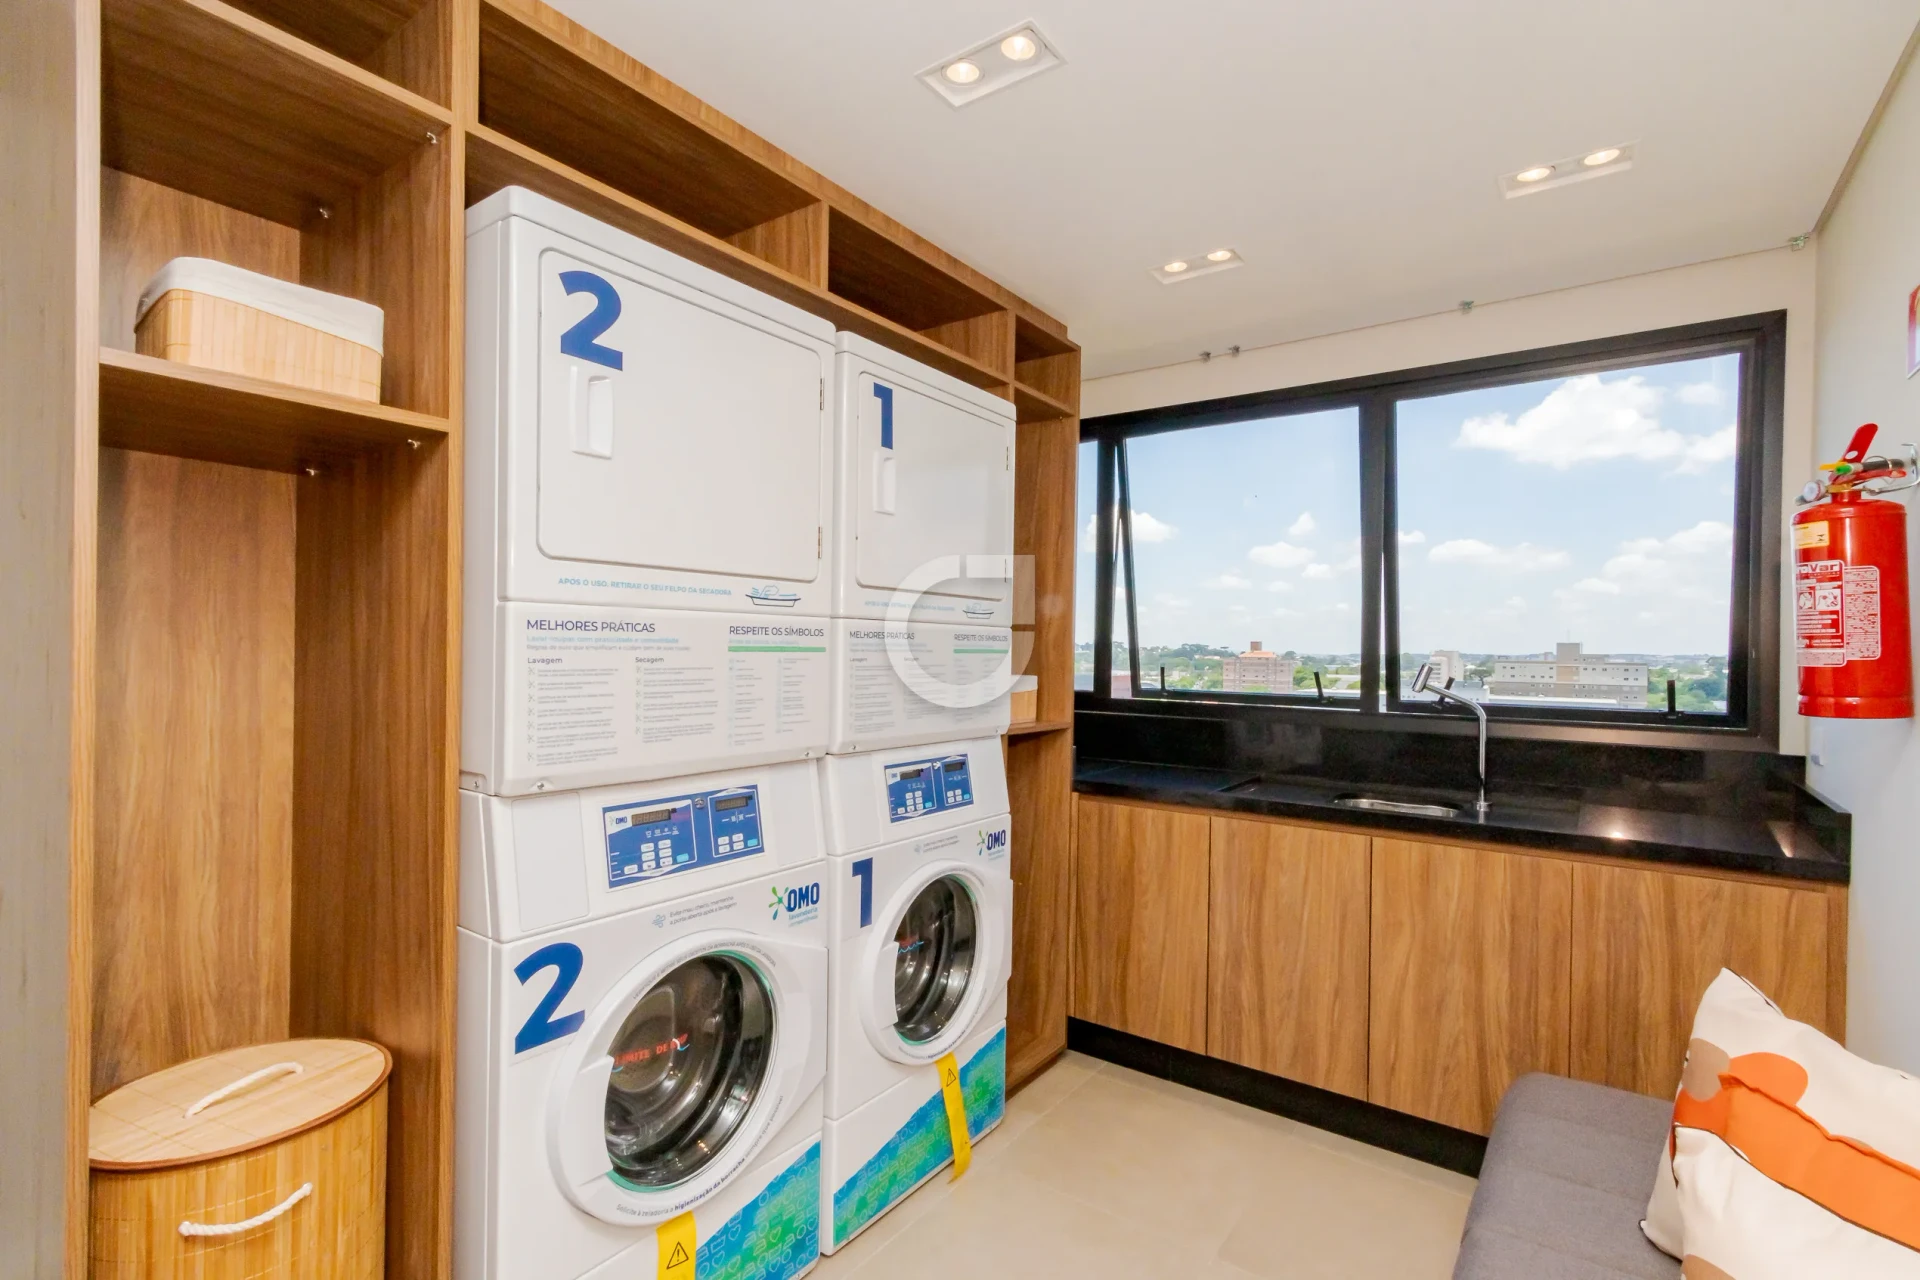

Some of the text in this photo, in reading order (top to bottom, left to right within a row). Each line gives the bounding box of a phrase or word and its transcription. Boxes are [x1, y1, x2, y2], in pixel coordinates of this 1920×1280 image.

[558, 270, 624, 371] 2
[873, 382, 894, 450] 1
[610, 580, 642, 590] RETIRAR
[698, 587, 732, 596] SECADORA
[526, 619, 656, 633] MELHORES PRÁTICAS
[729, 626, 824, 637] RESPEITE OS SÍMBOLOS
[849, 630, 886, 640] MELHORES
[954, 633, 977, 642] RESPEITE
[616, 816, 628, 824] OMO
[986, 829, 1006, 850] OMO
[786, 882, 820, 912] OMO
[852, 857, 874, 928] 1
[514, 942, 585, 1055] 2
[674, 1186, 712, 1211] higienização
[720, 1157, 746, 1184] borracha
